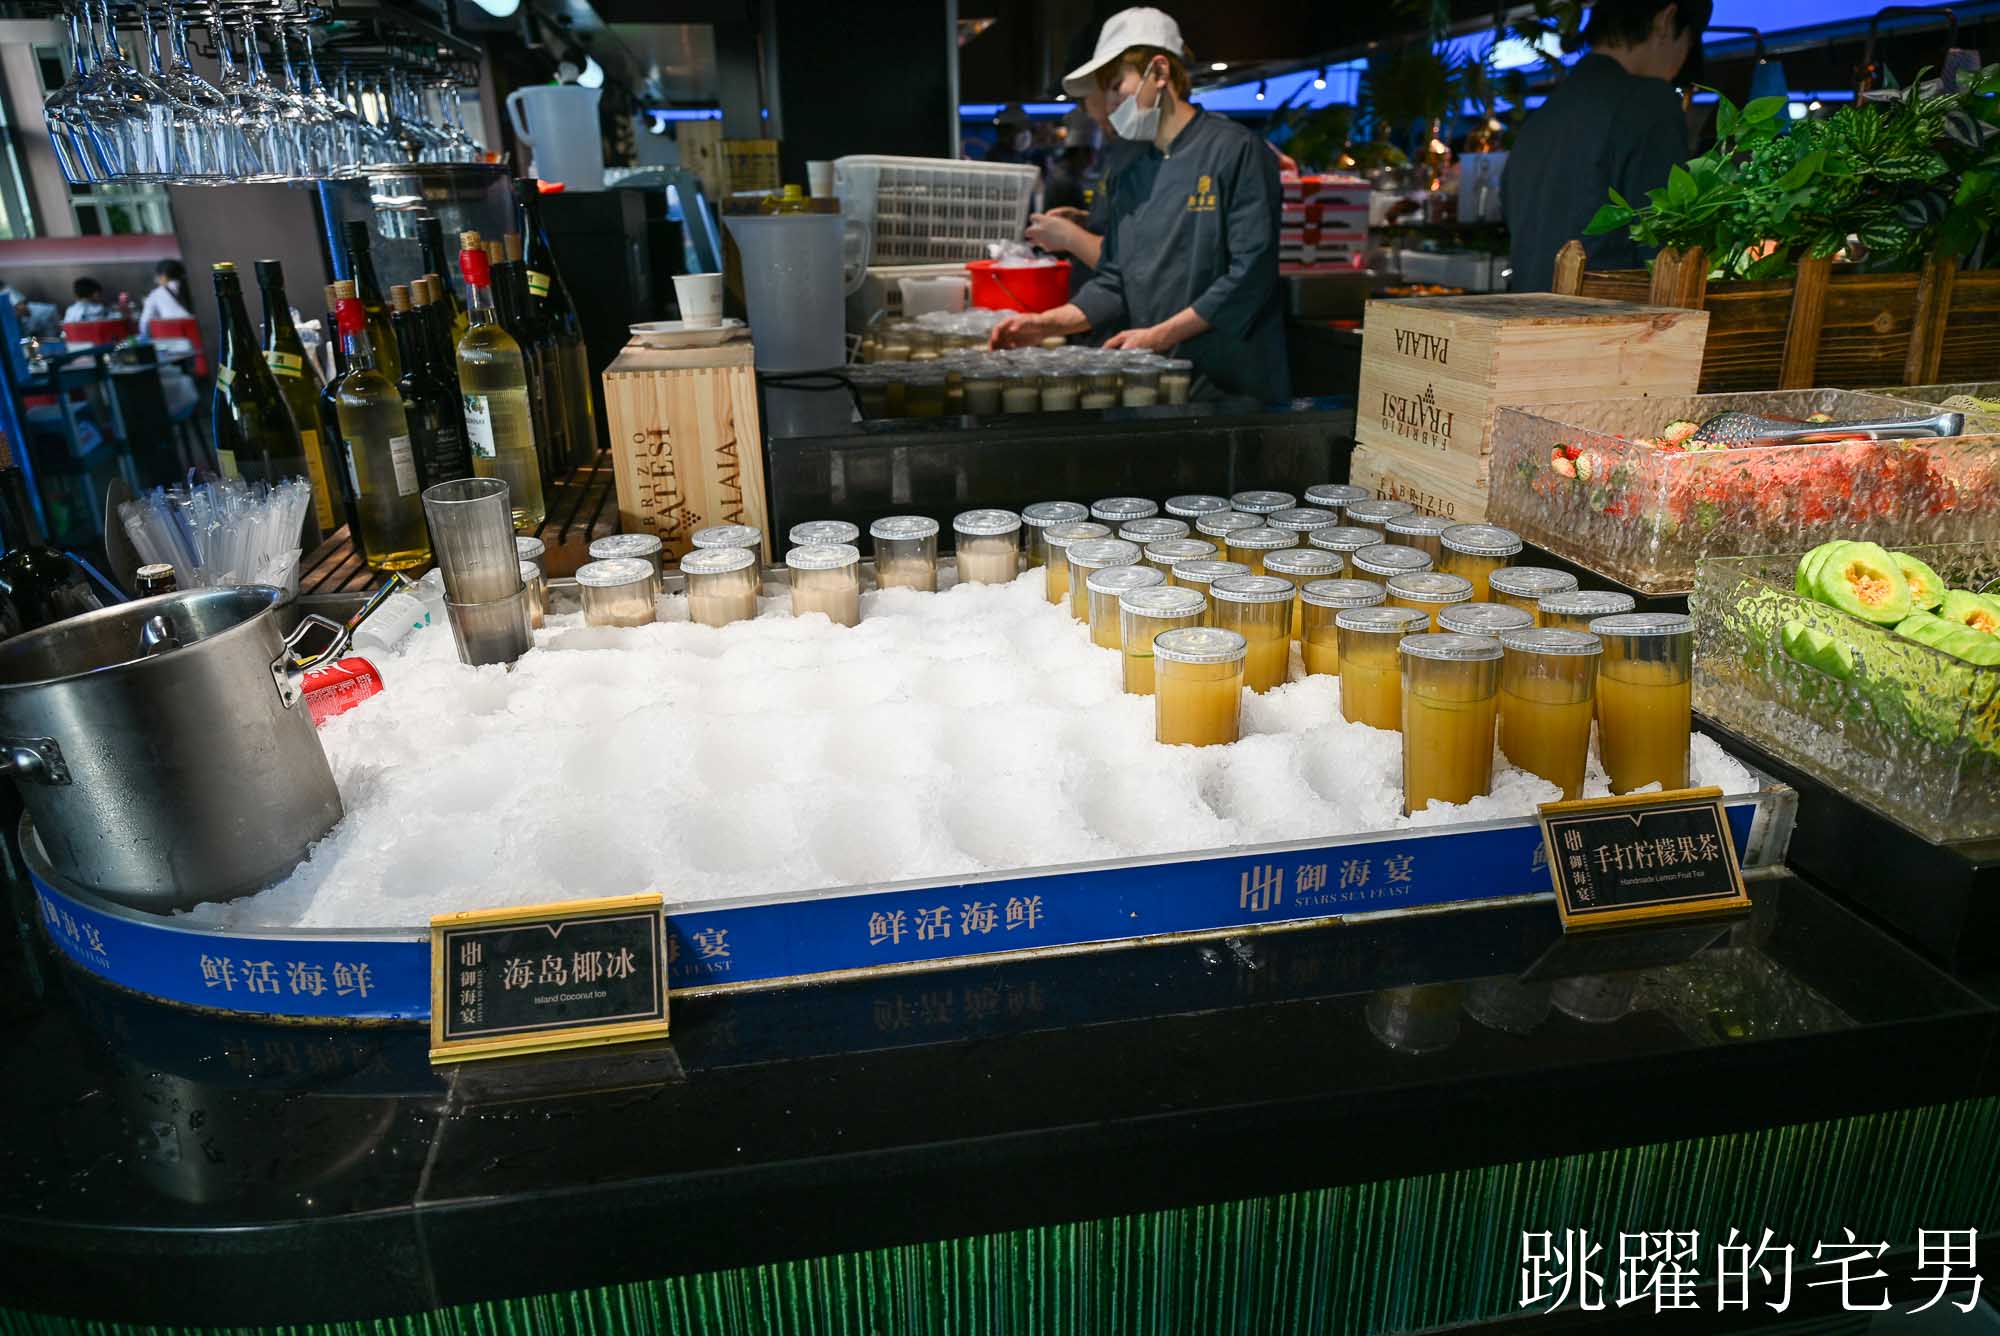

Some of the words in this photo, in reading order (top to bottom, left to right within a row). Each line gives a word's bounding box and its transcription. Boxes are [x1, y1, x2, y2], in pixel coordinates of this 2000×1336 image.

[1394, 328, 1449, 365] PALAIA
[1381, 392, 1454, 439] PRATESI
[1382, 420, 1448, 451] FABRIZIO
[633, 432, 656, 526] BRIZIO
[715, 437, 745, 525] ALAIA
[1295, 853, 1415, 894] 御海宴
[1593, 833, 1719, 874] 手打柠檬果茶
[1295, 893, 1337, 907] STARS
[1370, 884, 1412, 898] FEAST
[868, 895, 1045, 946] 鲜活海鲜
[200, 953, 376, 998] 鲜活海鲜
[503, 947, 637, 991] 海岛椰冰
[560, 991, 594, 1001] Coconut
[594, 990, 607, 998] Ice
